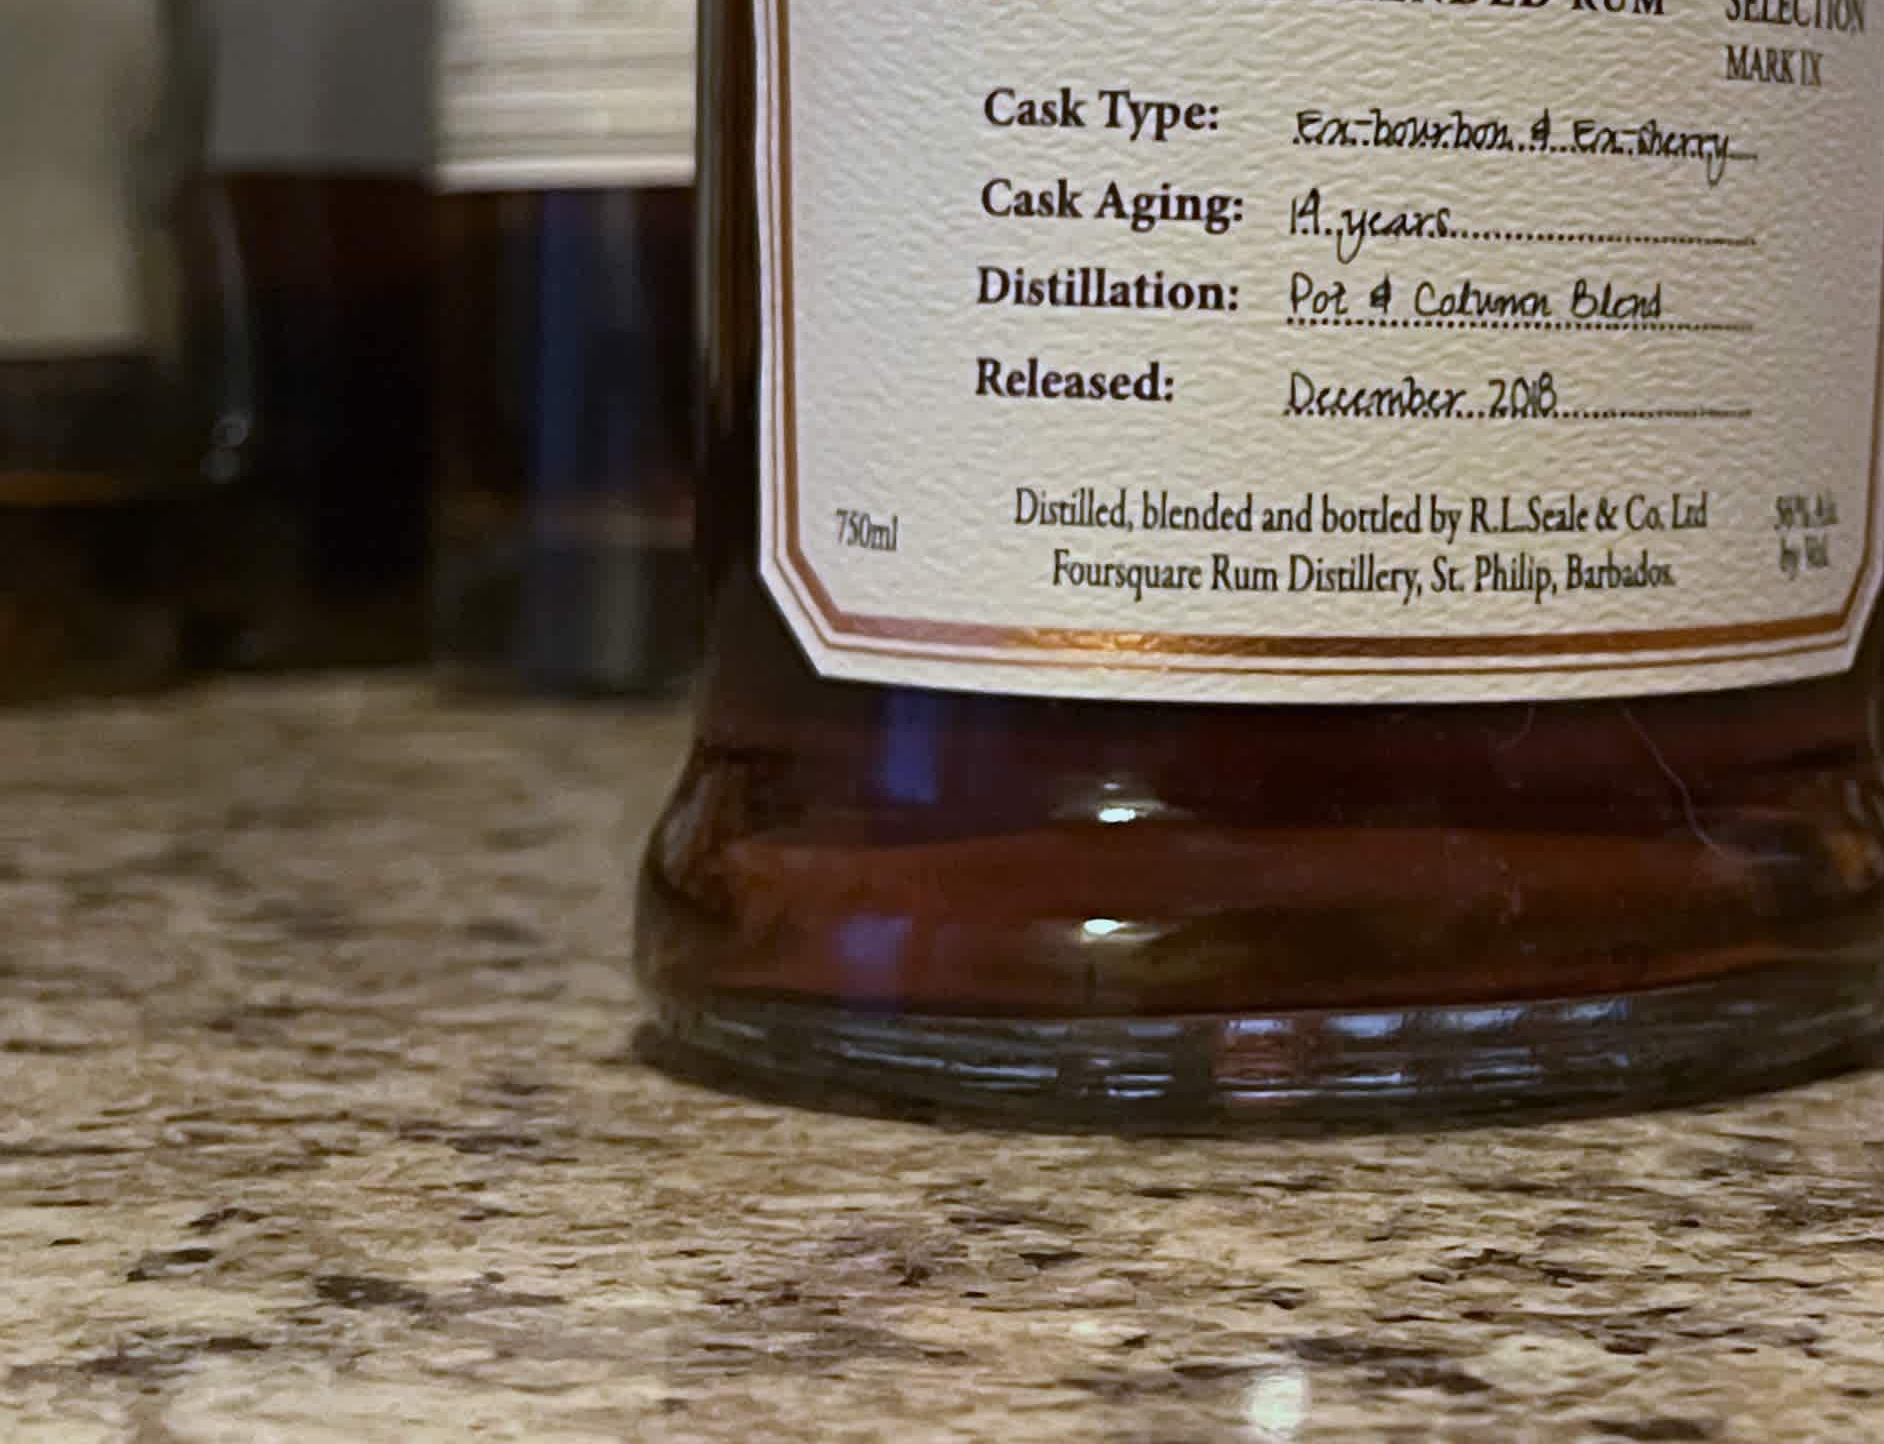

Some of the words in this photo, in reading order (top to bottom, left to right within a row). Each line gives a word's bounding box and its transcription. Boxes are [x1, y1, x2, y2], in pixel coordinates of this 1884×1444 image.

[1726, 44, 1795, 85] MARK
[1800, 49, 1824, 87] IX
[983, 86, 1087, 128] Cask
[1098, 88, 1219, 141] Type:
[981, 177, 1084, 219] Cask
[1094, 180, 1243, 235] Aging:
[977, 266, 1239, 311] Distillation:
[1290, 271, 1349, 315] Pot
[1370, 273, 1392, 315] &
[1414, 281, 1552, 318] Column
[1571, 278, 1664, 320] Blend
[975, 357, 1174, 401] Released:
[1288, 371, 1467, 416] December
[1488, 371, 1558, 417] 2018
[835, 508, 899, 552] 750ml
[1014, 487, 1133, 532] Distilled,
[1142, 490, 1253, 531] blended
[1261, 492, 1313, 533] and
[1321, 493, 1422, 535] bottled
[1429, 494, 1463, 545] by
[1598, 497, 1619, 531] &
[1671, 492, 1709, 529] Ltd
[1052, 548, 1203, 602] Foursquare
[1211, 553, 1278, 592] Rum
[1287, 553, 1422, 604] Distillery,
[1431, 555, 1464, 594] St.
[1474, 553, 1557, 604] Philip,
